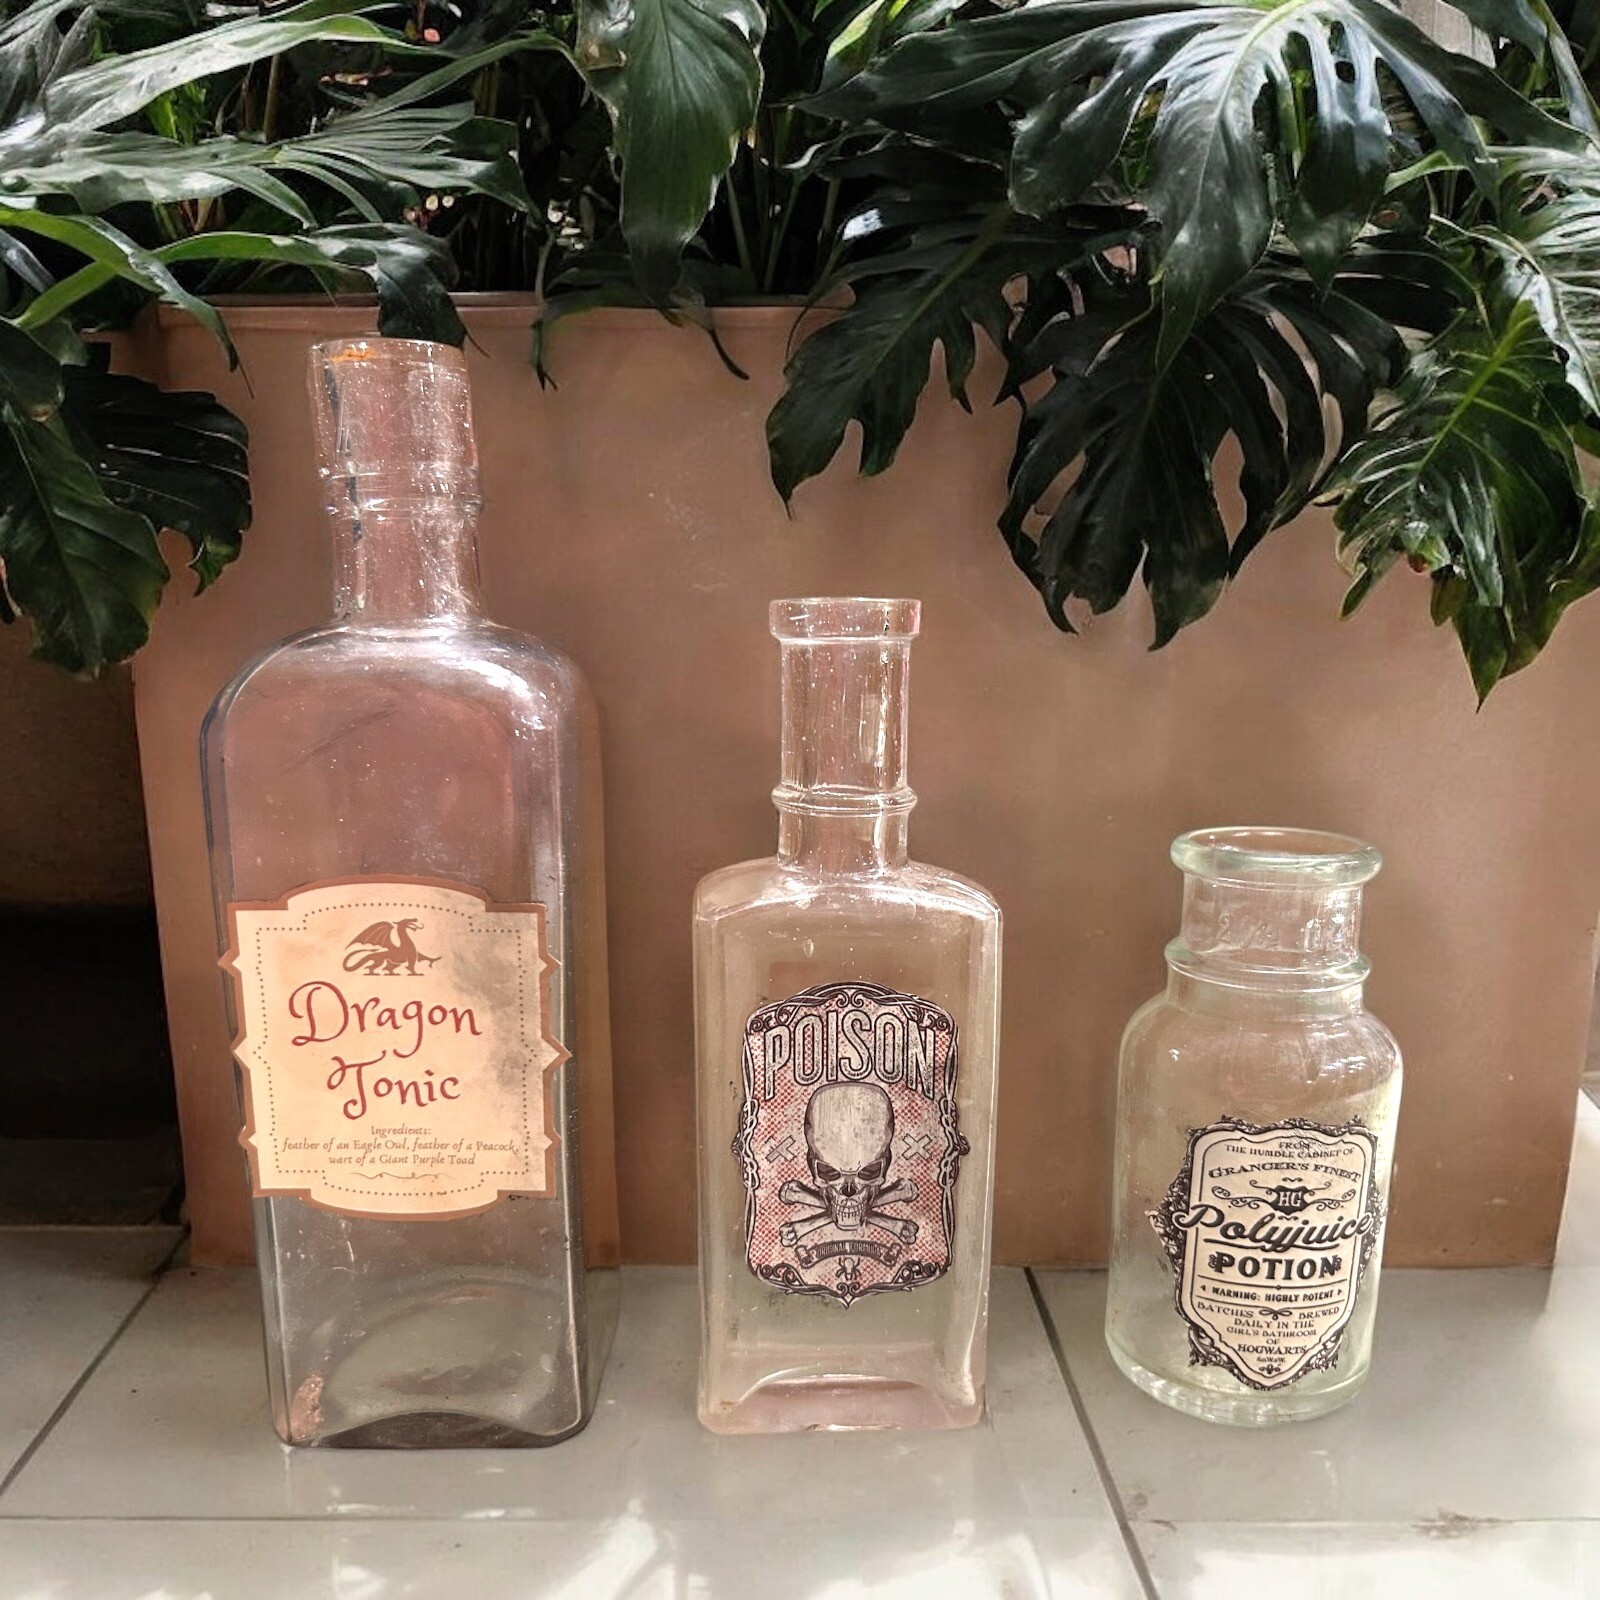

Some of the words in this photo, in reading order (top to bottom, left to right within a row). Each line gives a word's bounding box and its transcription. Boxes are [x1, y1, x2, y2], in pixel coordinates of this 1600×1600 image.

[288, 980, 483, 1058] Dragon
[763, 1010, 936, 1101] POISON
[326, 1050, 461, 1120] Tonic
[370, 1122, 432, 1139] Ingredients:
[281, 1137, 320, 1153] feather
[322, 1137, 335, 1153] of
[336, 1142, 350, 1150] an
[353, 1137, 382, 1153] Eagle
[411, 1137, 450, 1152] feather
[452, 1137, 465, 1153] of
[466, 1142, 473, 1150] a
[1224, 1144, 1247, 1154] THE
[1249, 1148, 1295, 1158] HUMBLE
[1342, 1146, 1356, 1156] OF
[329, 1155, 353, 1164] wart
[355, 1151, 368, 1167] of
[369, 1156, 376, 1164] a
[379, 1153, 409, 1164] Giant
[412, 1152, 445, 1168] Purple
[448, 1152, 476, 1165] Toad
[1207, 1161, 1310, 1179] GRANGER'S
[1313, 1163, 1362, 1183] FINEST
[1278, 1190, 1302, 1208] HG
[1173, 1203, 1373, 1253] Polyjuice
[1214, 1251, 1339, 1281] POTION
[1211, 1286, 1261, 1301] WARNING:
[1265, 1293, 1300, 1303] HIGHLY
[1302, 1289, 1335, 1301] POTENT
[1197, 1301, 1254, 1318] BATCHES
[1298, 1306, 1340, 1320] BREWED
[1233, 1318, 1273, 1329] DAILY
[1277, 1319, 1290, 1329] IN
[1292, 1319, 1316, 1329] THE
[1262, 1329, 1317, 1338] BATHROOM
[1265, 1338, 1281, 1346] OF
[1237, 1343, 1308, 1355] HOGWARTS
